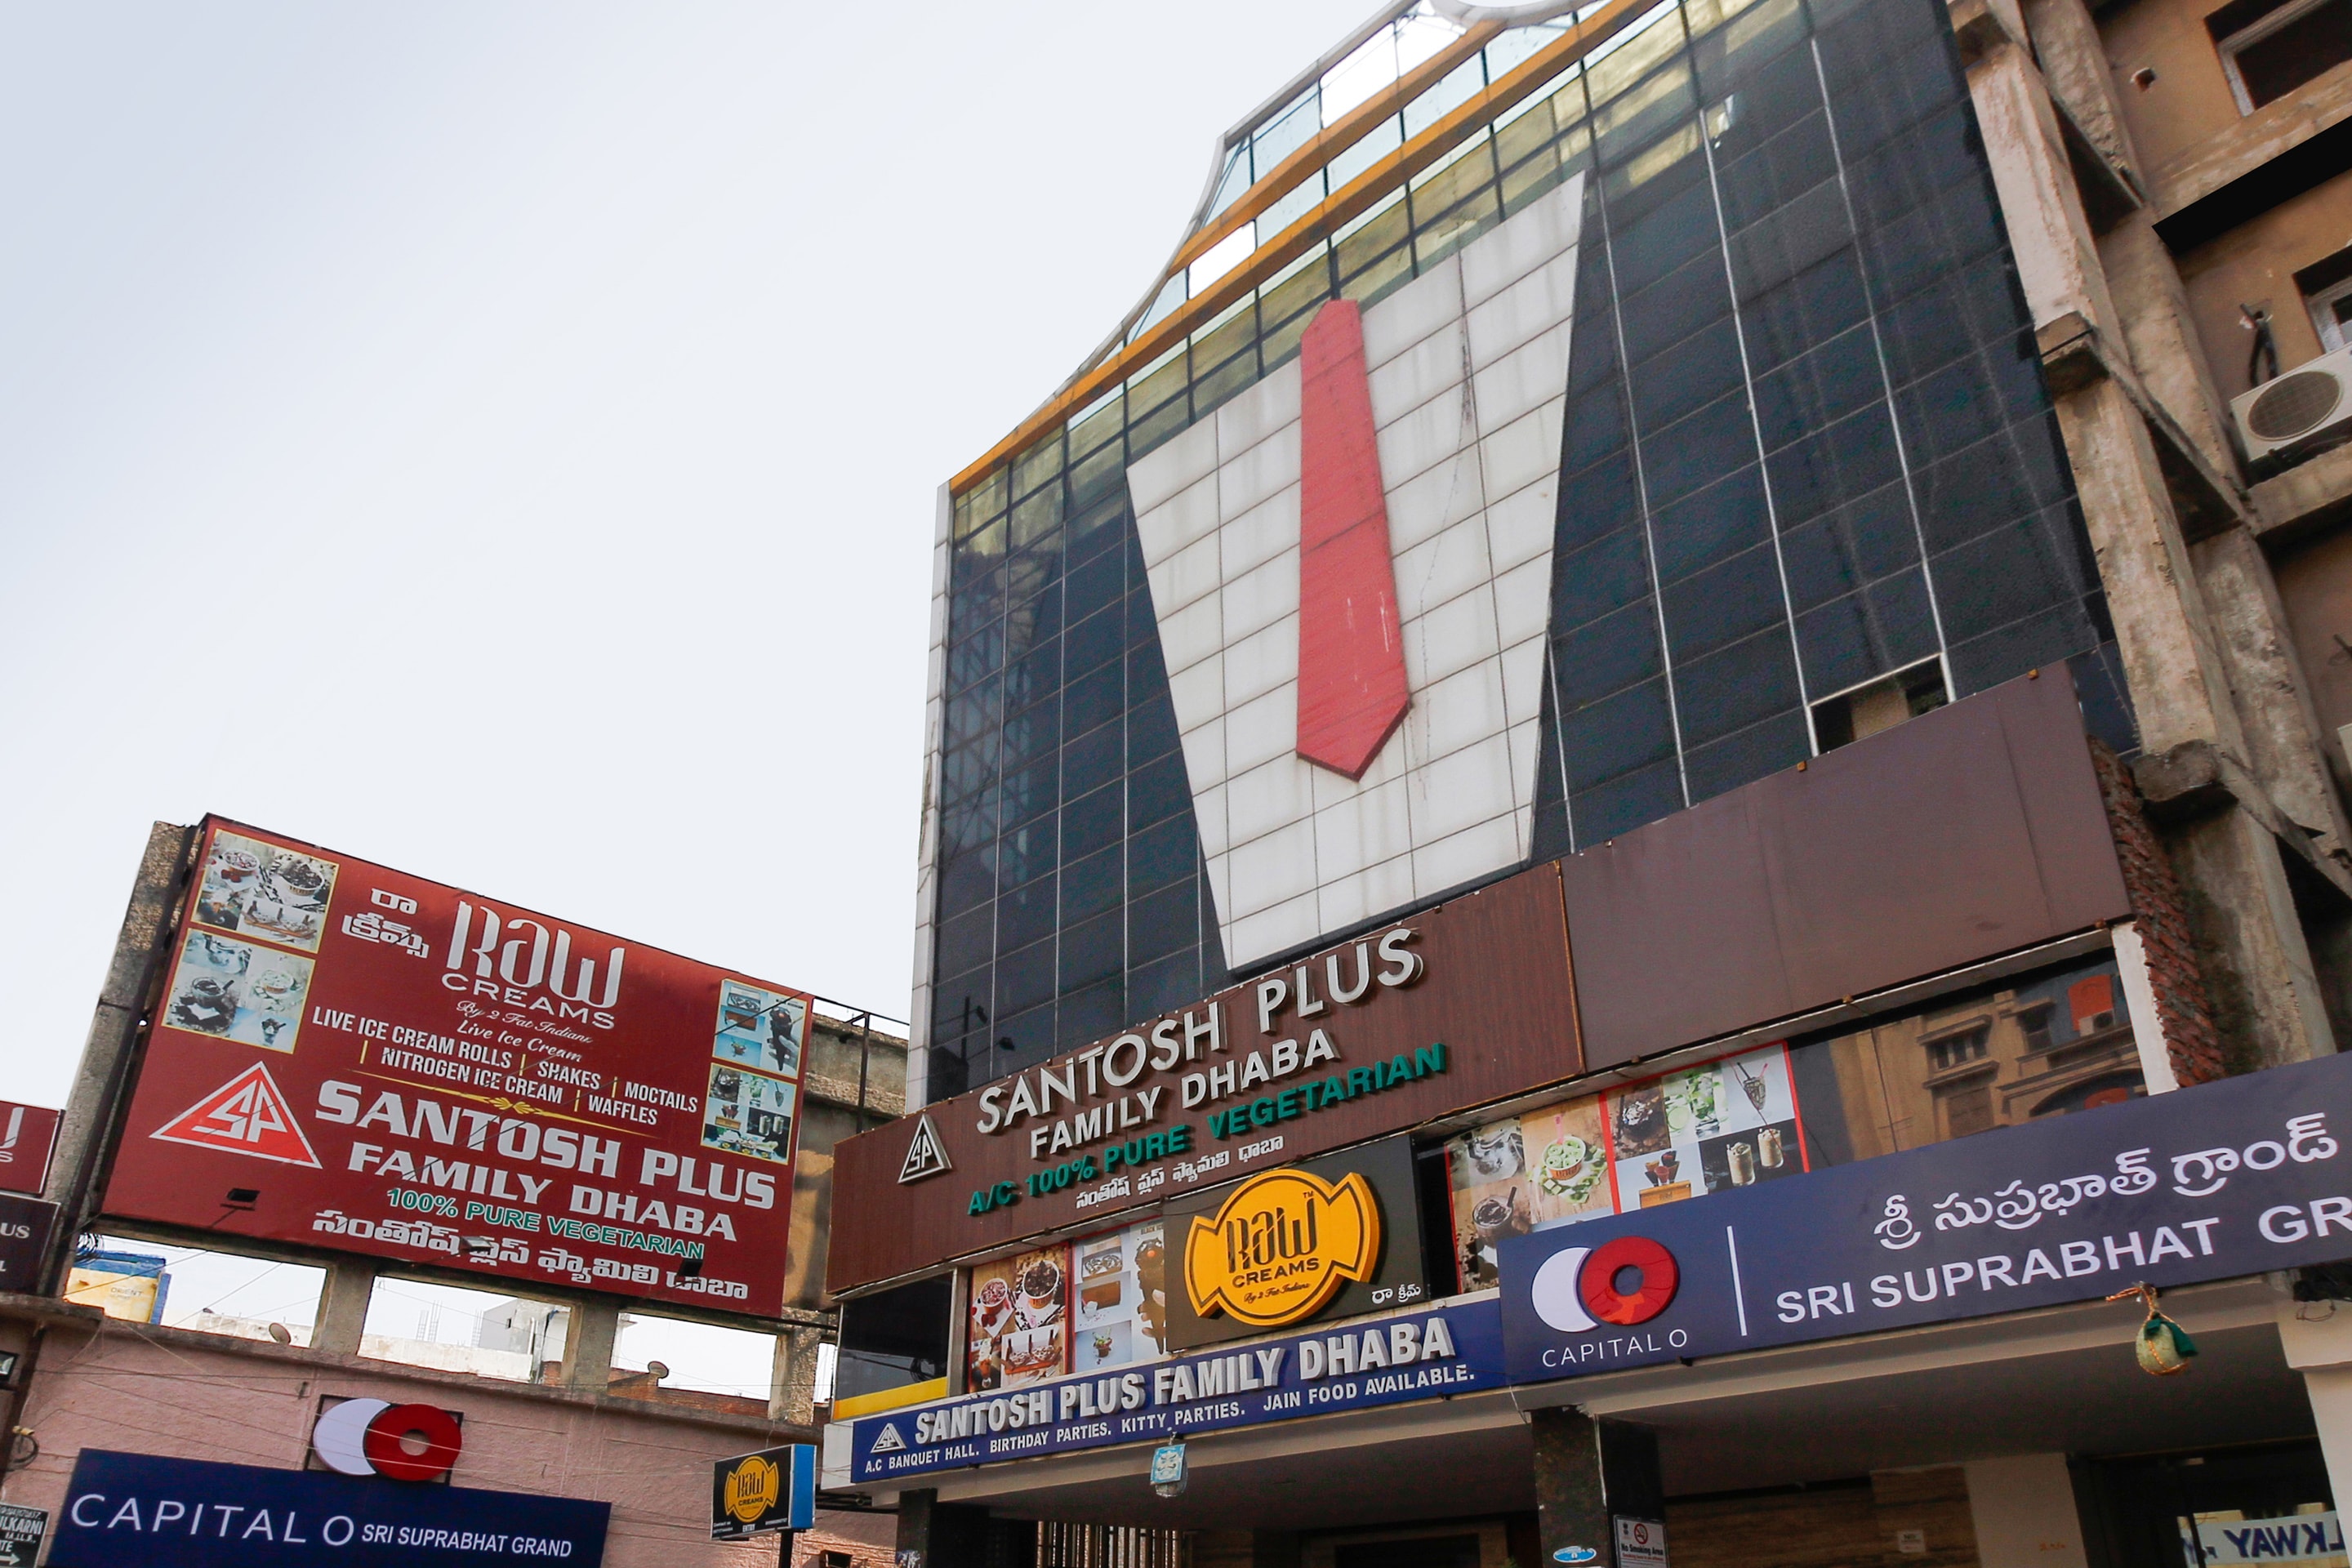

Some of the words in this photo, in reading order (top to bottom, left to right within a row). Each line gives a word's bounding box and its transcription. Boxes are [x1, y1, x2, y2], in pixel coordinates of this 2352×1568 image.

[442, 973, 614, 1030] CREAMS
[457, 1000, 485, 1018] By
[487, 1009, 500, 1020] 2
[501, 1012, 534, 1029] Fat
[457, 1019, 492, 1040] Live
[498, 1031, 522, 1048] Ice
[528, 1038, 582, 1062] Cream
[977, 1001, 1227, 1134] SANTOSH
[1258, 928, 1423, 1035] PLUS
[312, 1005, 355, 1032] LIVE
[358, 1018, 387, 1040] ICE
[392, 1026, 457, 1056] CREAM
[458, 1043, 511, 1068] ROLLS
[537, 1061, 601, 1090] SHAKES
[625, 1081, 698, 1113] MOCTAILS
[381, 1047, 470, 1084] NITROGEN
[474, 1070, 503, 1089] ICE
[506, 1076, 563, 1104] CREAM
[588, 1094, 657, 1125] WAFFLES
[1031, 1085, 1162, 1159] FAMILY
[1182, 1028, 1341, 1109] DHABA
[315, 1080, 621, 1178] SANTOSH
[639, 1148, 776, 1209] PLUS
[968, 1181, 1021, 1216] A/C
[1026, 1155, 1098, 1197] 100%
[1104, 1125, 1191, 1174] PURE
[1208, 1043, 1446, 1138] VEGETARIAN
[348, 1141, 552, 1205] FAMILY
[569, 1185, 737, 1242] DHABA
[387, 1188, 457, 1217] 100%
[465, 1202, 540, 1232] PURE
[547, 1217, 705, 1260] VEGETARIAN
[1232, 1258, 1319, 1288] CREAMS
[1776, 1282, 1855, 1324] SRI
[1869, 1217, 2221, 1307] SUPRABHAT
[2258, 1196, 2352, 1244] GR
[915, 1388, 1054, 1444] SANTOSH
[1060, 1373, 1145, 1421] PLUS
[1154, 1348, 1285, 1405] FAMILY
[1299, 1317, 1455, 1380] DHABA
[1542, 1334, 1661, 1368] CAPITAL
[1669, 1329, 1687, 1348] O
[865, 1459, 882, 1473] A.C
[889, 1450, 940, 1469] BANQUET
[945, 1441, 979, 1460] HALL.
[990, 1431, 1049, 1453] BIRTHDAY
[1057, 1422, 1111, 1443] PARTIES.
[1121, 1413, 1167, 1433] KITTY
[1174, 1401, 1245, 1426] PARTIES.
[1263, 1392, 1300, 1411] JAIN
[1308, 1382, 1357, 1403] FOOD
[1365, 1365, 1474, 1396] AVAILABLE.
[71, 1494, 308, 1544] CAPITAL
[323, 1515, 355, 1546] O
[362, 1524, 394, 1544] SRI
[398, 1526, 508, 1553] SUPRABHAT
[511, 1536, 571, 1557] GRAND
[738, 1497, 764, 1506] CREAMS
[1629, 1544, 1650, 1556] Smoking
